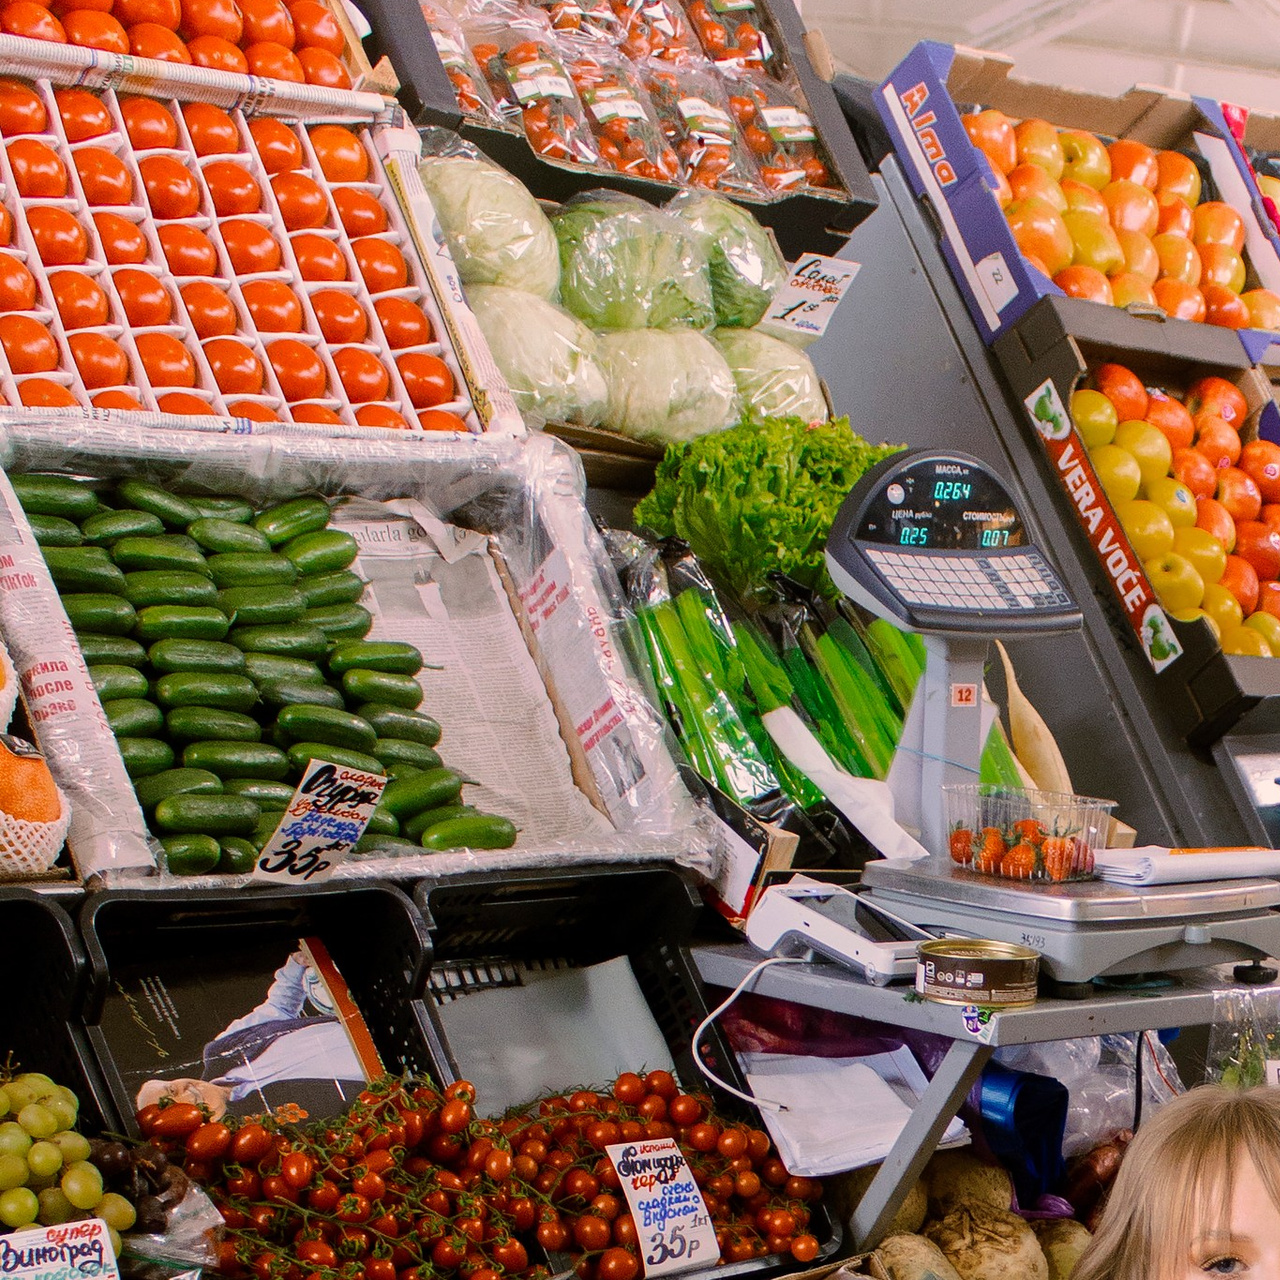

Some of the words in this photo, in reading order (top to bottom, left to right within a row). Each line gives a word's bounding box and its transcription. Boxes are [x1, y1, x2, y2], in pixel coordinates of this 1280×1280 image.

[900, 81, 958, 188] Alma
[892, 509, 914, 519] ЦЕНА
[1057, 443, 1104, 534] VERA
[1098, 527, 1146, 613] VOĆE
[957, 688, 972, 702] 12
[46, 1223, 102, 1246] супер
[0, 1240, 104, 1272] Виноград
